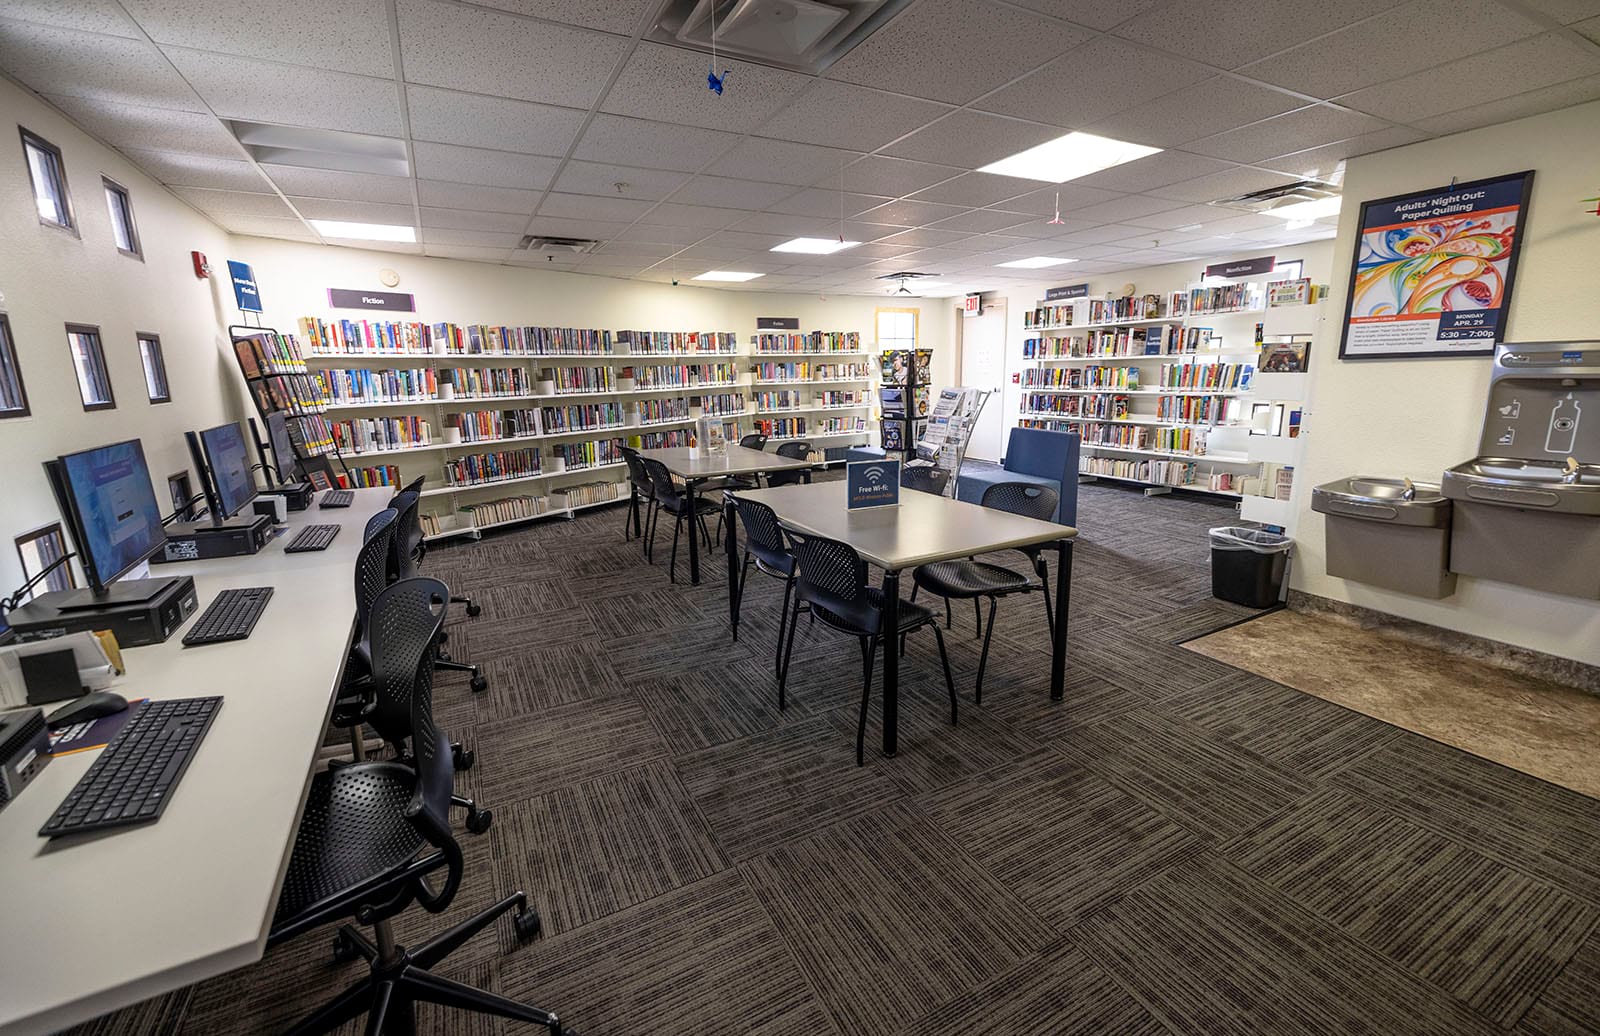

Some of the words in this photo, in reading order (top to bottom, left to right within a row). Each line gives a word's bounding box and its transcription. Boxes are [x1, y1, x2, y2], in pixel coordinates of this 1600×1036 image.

[1394, 200, 1430, 212] Adults'
[1431, 195, 1460, 207] Night
[1461, 191, 1485, 201] Out:
[1401, 210, 1431, 220] Paper
[1432, 203, 1474, 216] Quilling
[361, 296, 385, 305] Fiction
[966, 297, 978, 311] EXIT
[1469, 330, 1494, 338] 7:00p
[858, 486, 872, 494] Free
